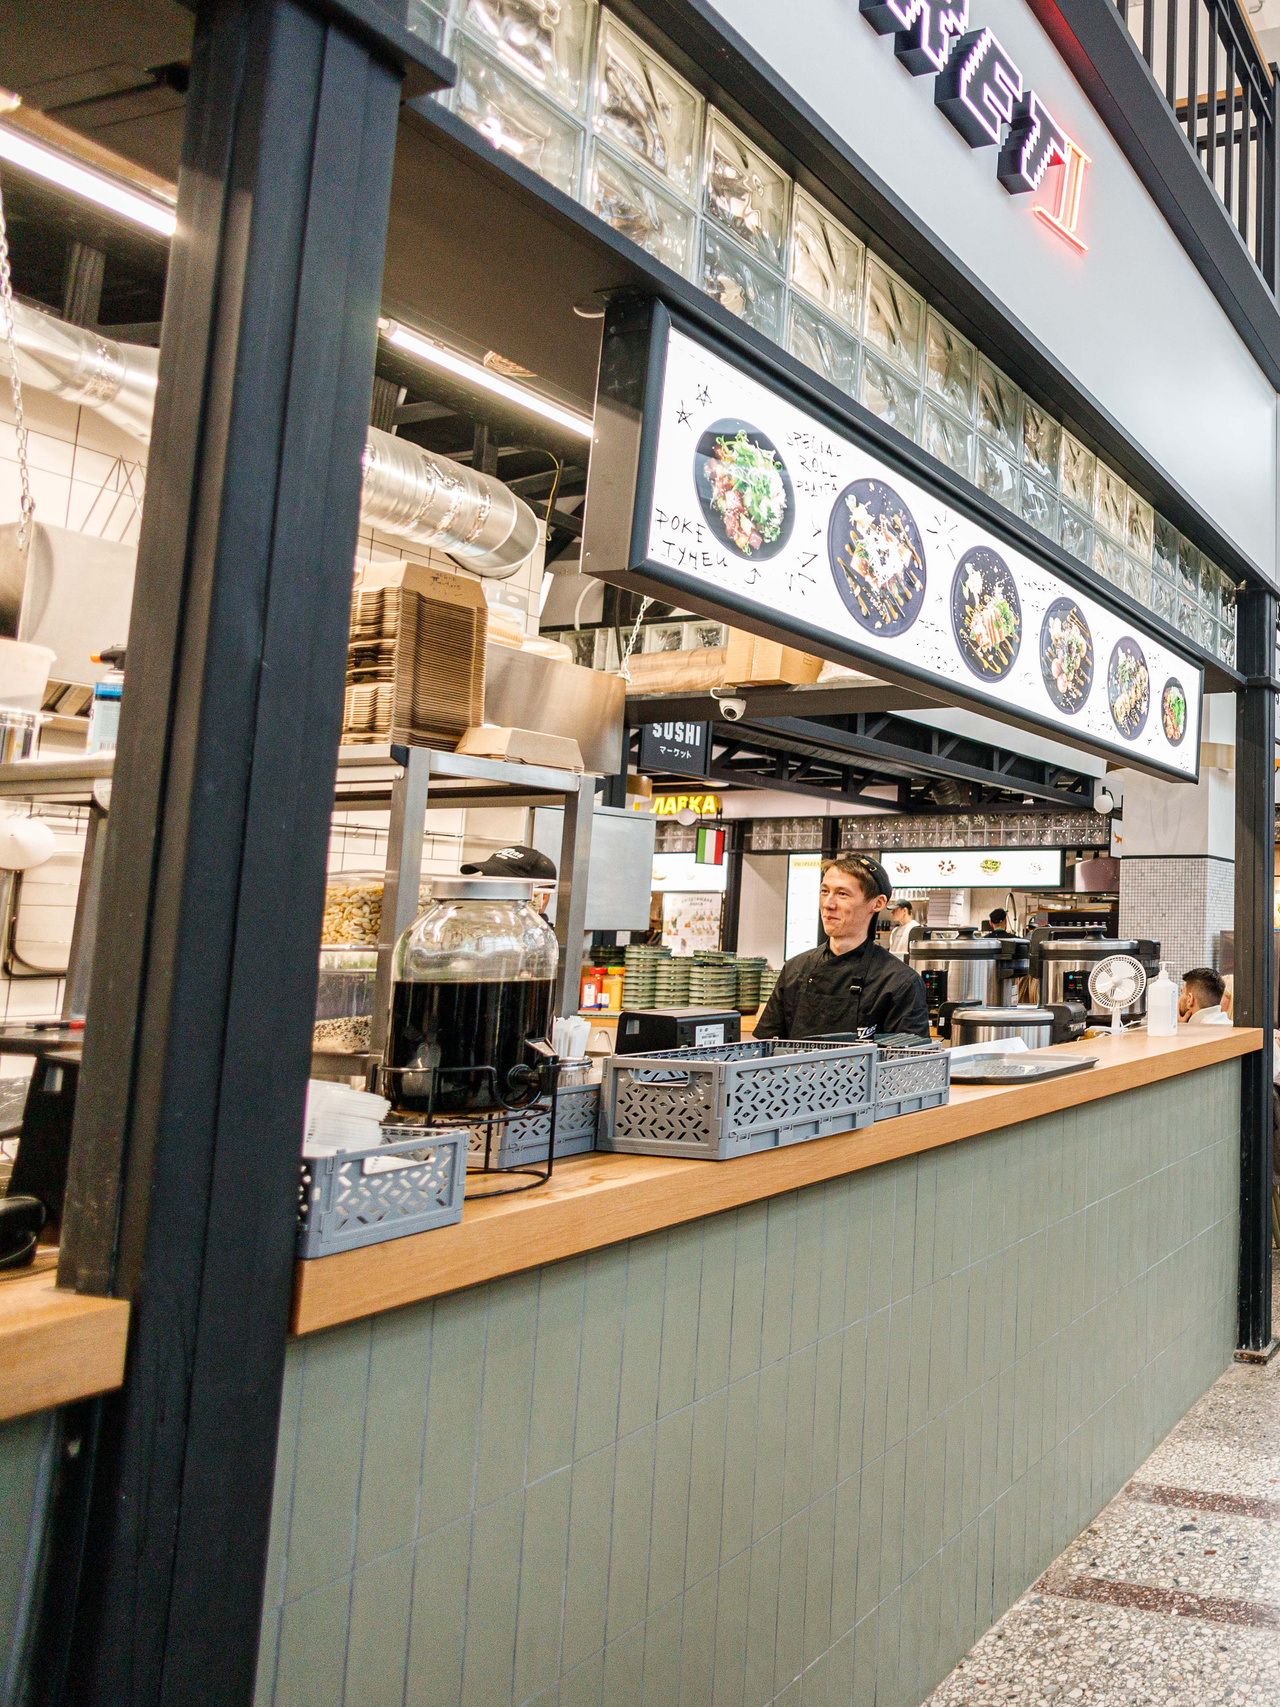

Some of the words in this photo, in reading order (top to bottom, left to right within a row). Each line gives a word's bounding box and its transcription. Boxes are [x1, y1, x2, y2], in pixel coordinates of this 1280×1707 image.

[787, 431, 842, 458] SPECIA
[652, 721, 701, 747] SUSHI
[649, 795, 717, 815] ЛАВКА
